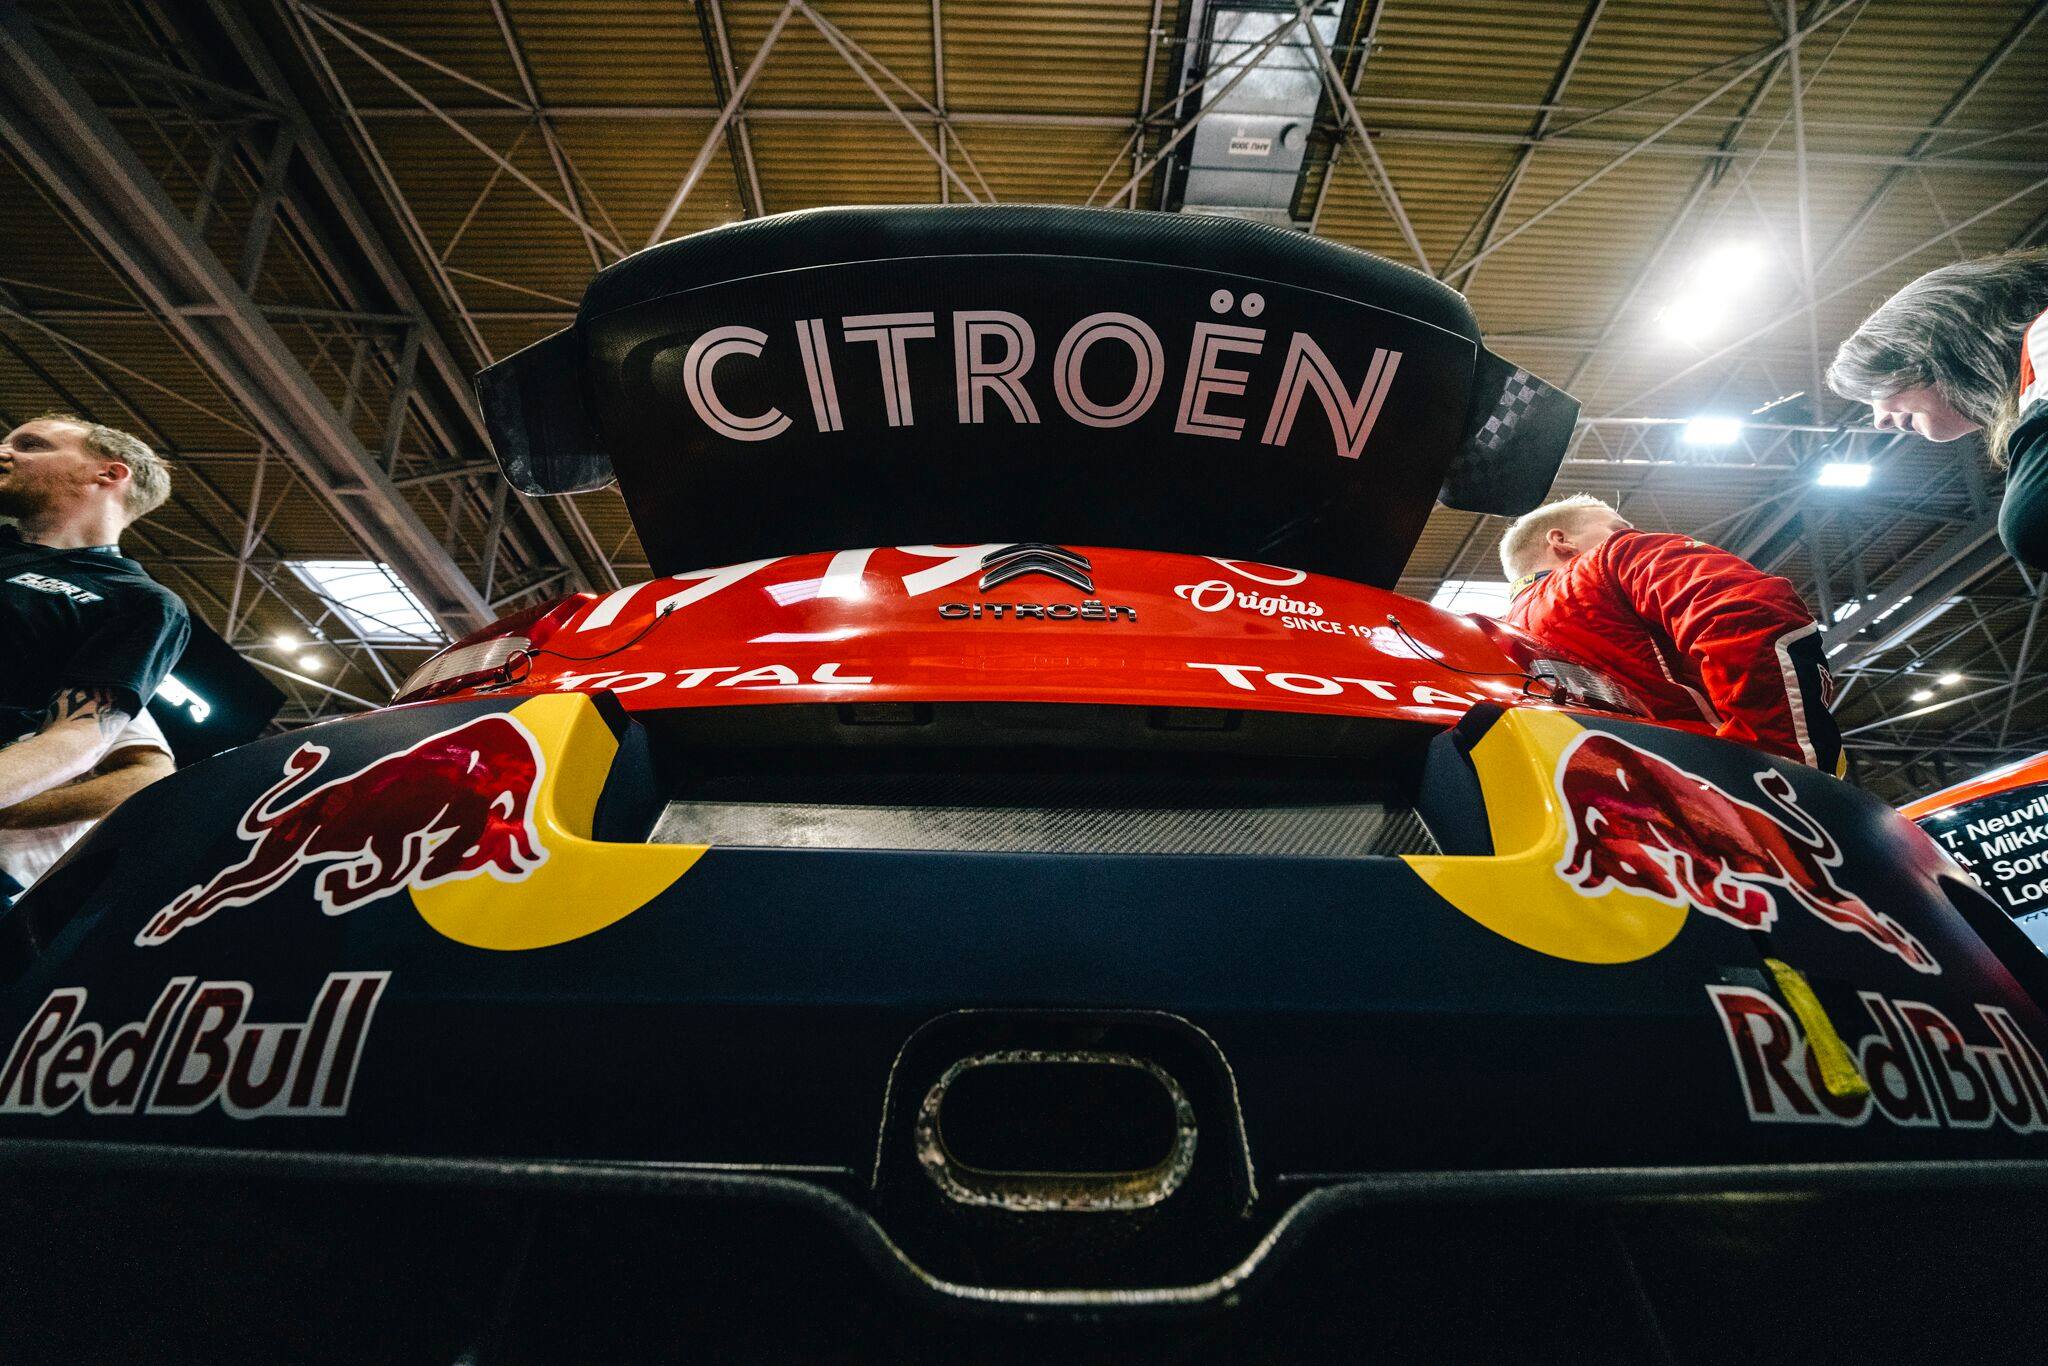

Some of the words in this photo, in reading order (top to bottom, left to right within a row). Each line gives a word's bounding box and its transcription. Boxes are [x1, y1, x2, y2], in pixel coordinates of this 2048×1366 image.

[683, 289, 1402, 459] CITROËN
[1174, 580, 1324, 617] Origins
[1281, 616, 1346, 635] SINCE
[551, 663, 873, 693] TOTAL
[1940, 830, 1964, 849] T.
